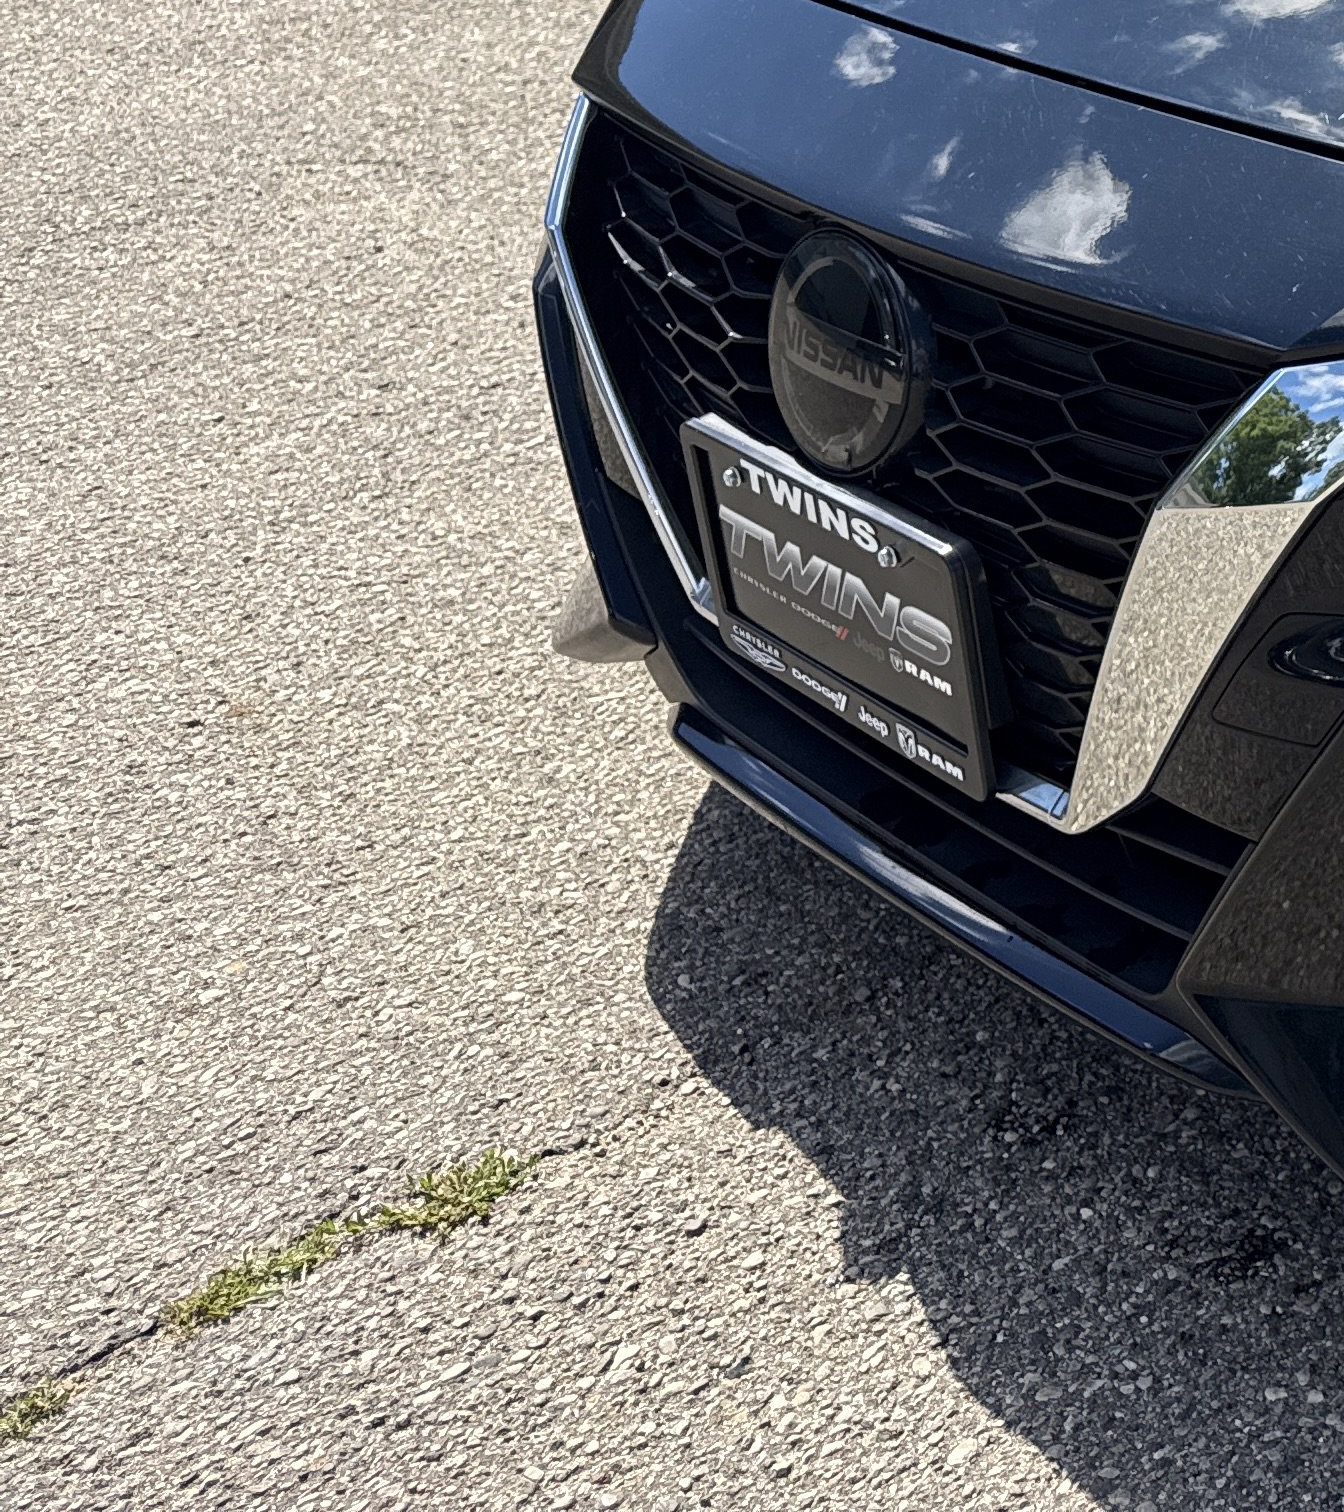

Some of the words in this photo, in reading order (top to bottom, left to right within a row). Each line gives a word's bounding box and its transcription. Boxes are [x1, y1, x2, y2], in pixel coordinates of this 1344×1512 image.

[784, 321, 884, 390] NISSAN
[740, 458, 879, 553] TWINS
[719, 504, 953, 666] TWINS
[733, 568, 787, 604] CHRYSLER
[791, 601, 839, 634] DODGE
[853, 632, 885, 662] Jeep
[904, 659, 953, 696] RAM
[732, 624, 783, 659] CHRYSLER
[792, 667, 839, 705] DODGE
[858, 705, 890, 738] Jeep
[917, 743, 964, 782] RAM
